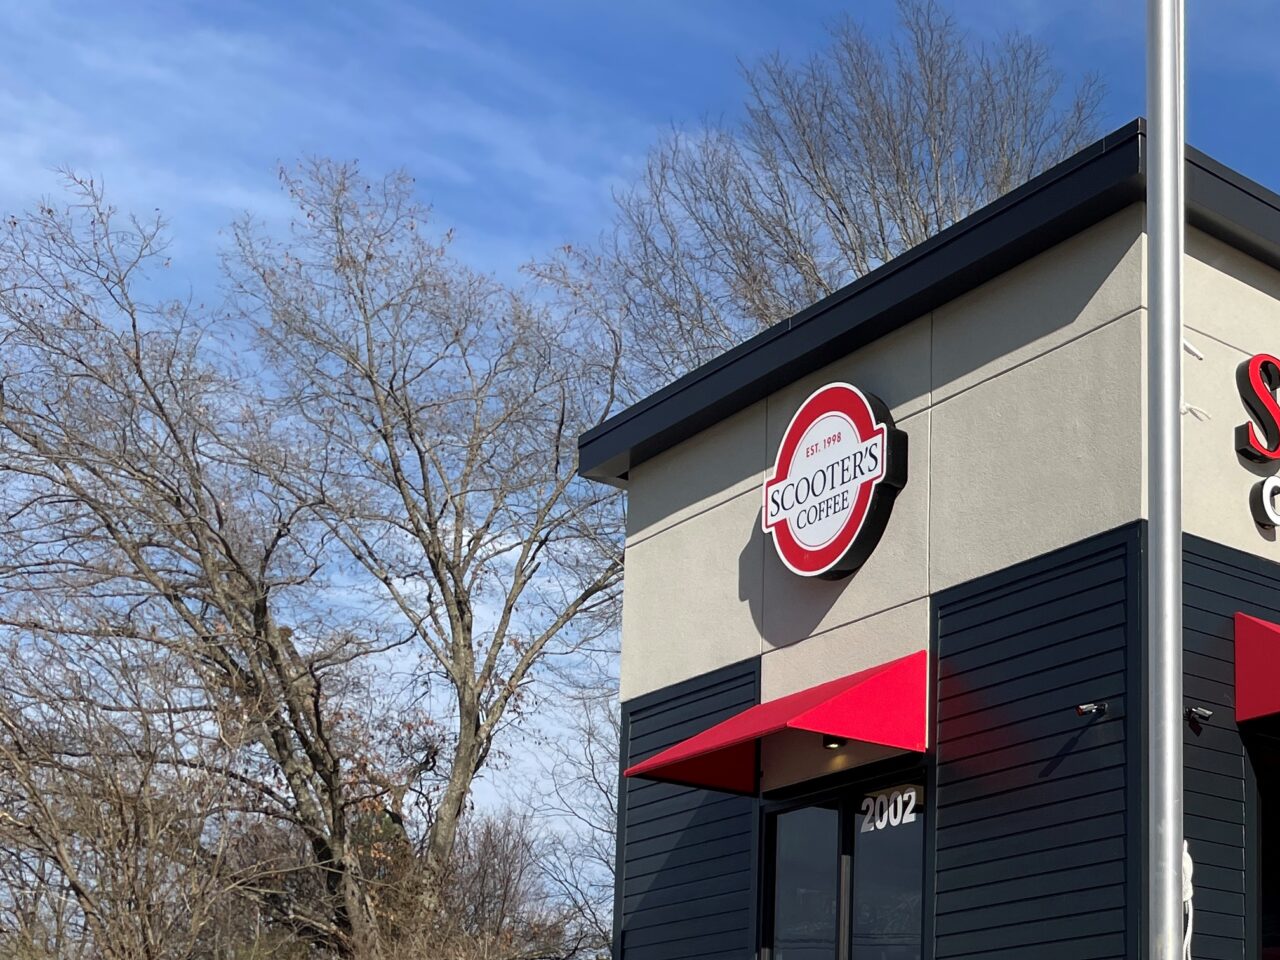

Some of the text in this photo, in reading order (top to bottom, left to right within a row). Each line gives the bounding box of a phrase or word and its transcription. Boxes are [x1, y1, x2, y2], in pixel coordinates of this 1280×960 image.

[806, 431, 842, 458] EST. 1998
[770, 442, 879, 517] SCOOTER'S
[796, 490, 849, 530] COFFEE
[860, 787, 917, 833] 2002
